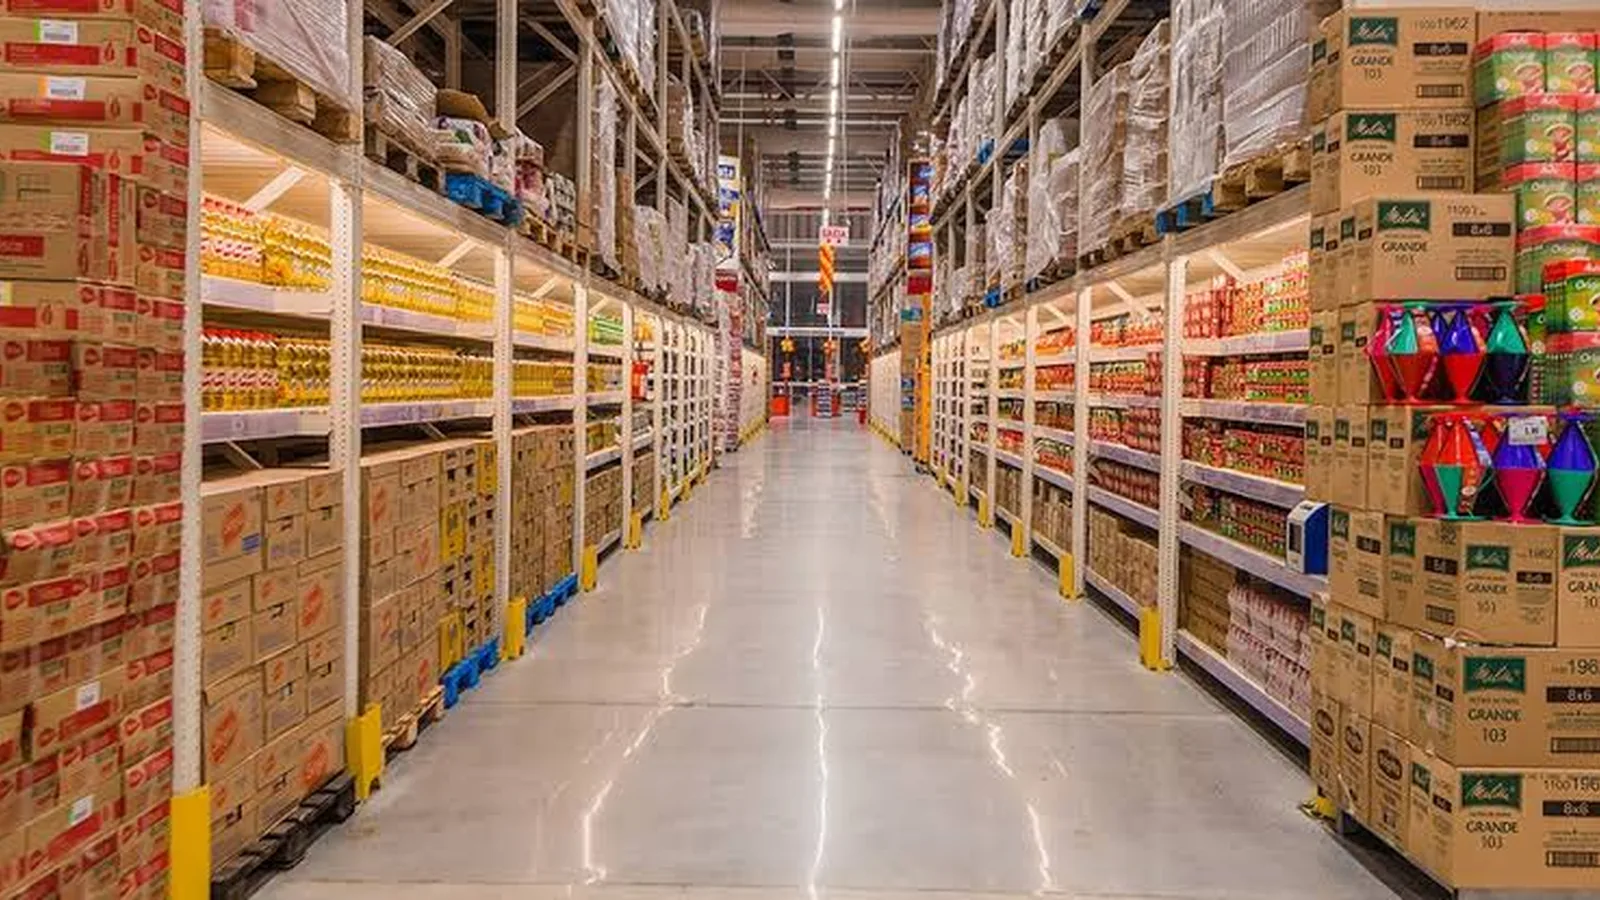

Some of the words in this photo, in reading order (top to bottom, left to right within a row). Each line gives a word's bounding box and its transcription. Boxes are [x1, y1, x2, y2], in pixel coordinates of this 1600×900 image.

[1351, 56, 1393, 66] GRANDE
[1350, 152, 1393, 163] GRANDE
[1381, 241, 1427, 252] GRANDE
[1465, 582, 1508, 594] GRANDE
[1567, 689, 1593, 701] 8x6
[1468, 708, 1522, 722] GRANDE
[1482, 727, 1507, 743] 103
[1562, 801, 1591, 816] 8x6
[1466, 821, 1519, 834] GRANDE
[1480, 835, 1504, 849] 103
